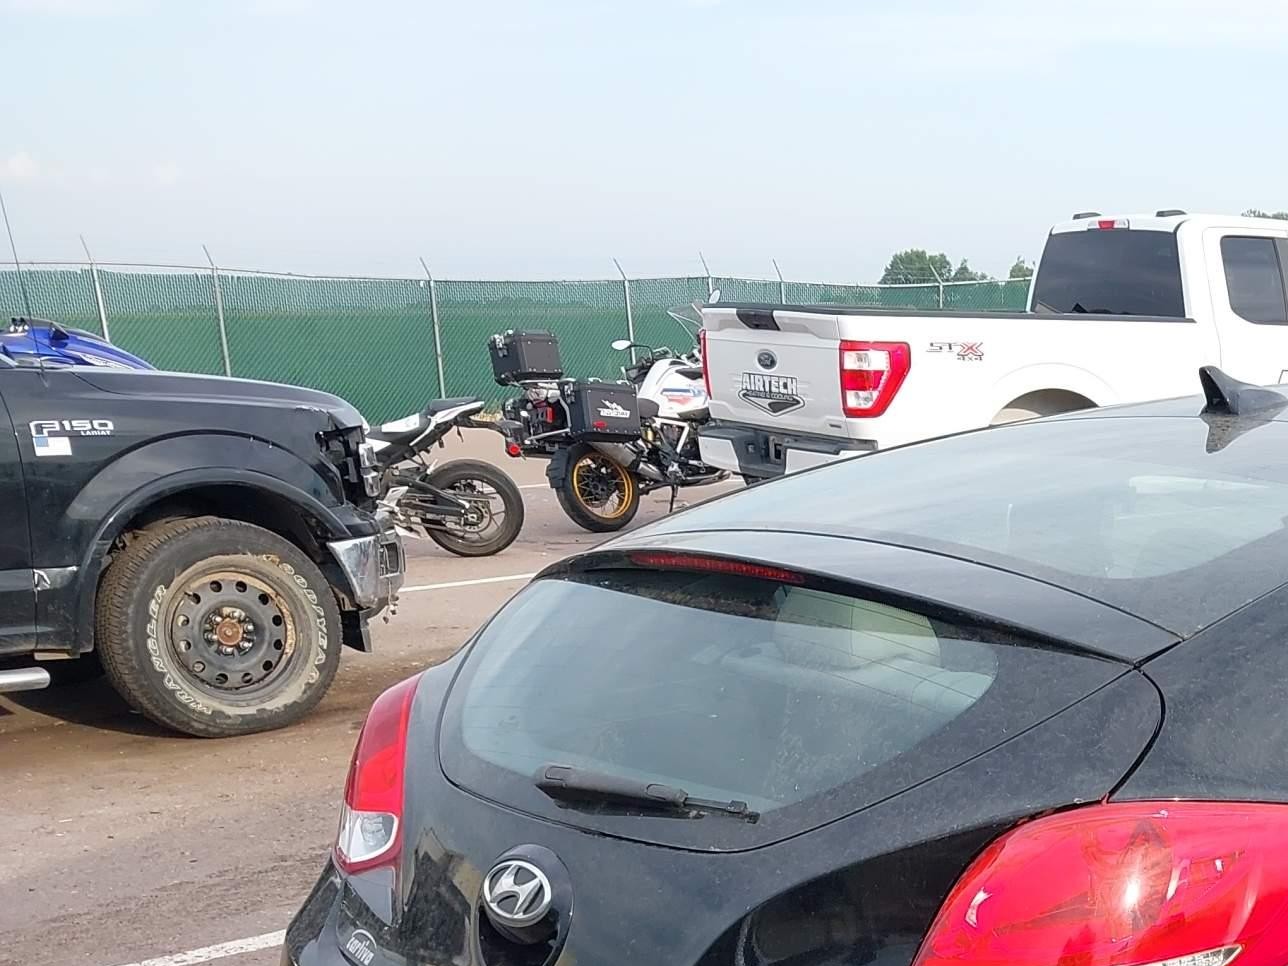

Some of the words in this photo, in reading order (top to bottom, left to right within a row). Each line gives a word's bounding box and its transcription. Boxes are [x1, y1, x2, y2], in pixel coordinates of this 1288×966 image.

[926, 342, 984, 356] STX
[742, 373, 797, 395] AIRTECH
[29, 420, 114, 437] F150
[147, 584, 212, 715] WRANGLER
